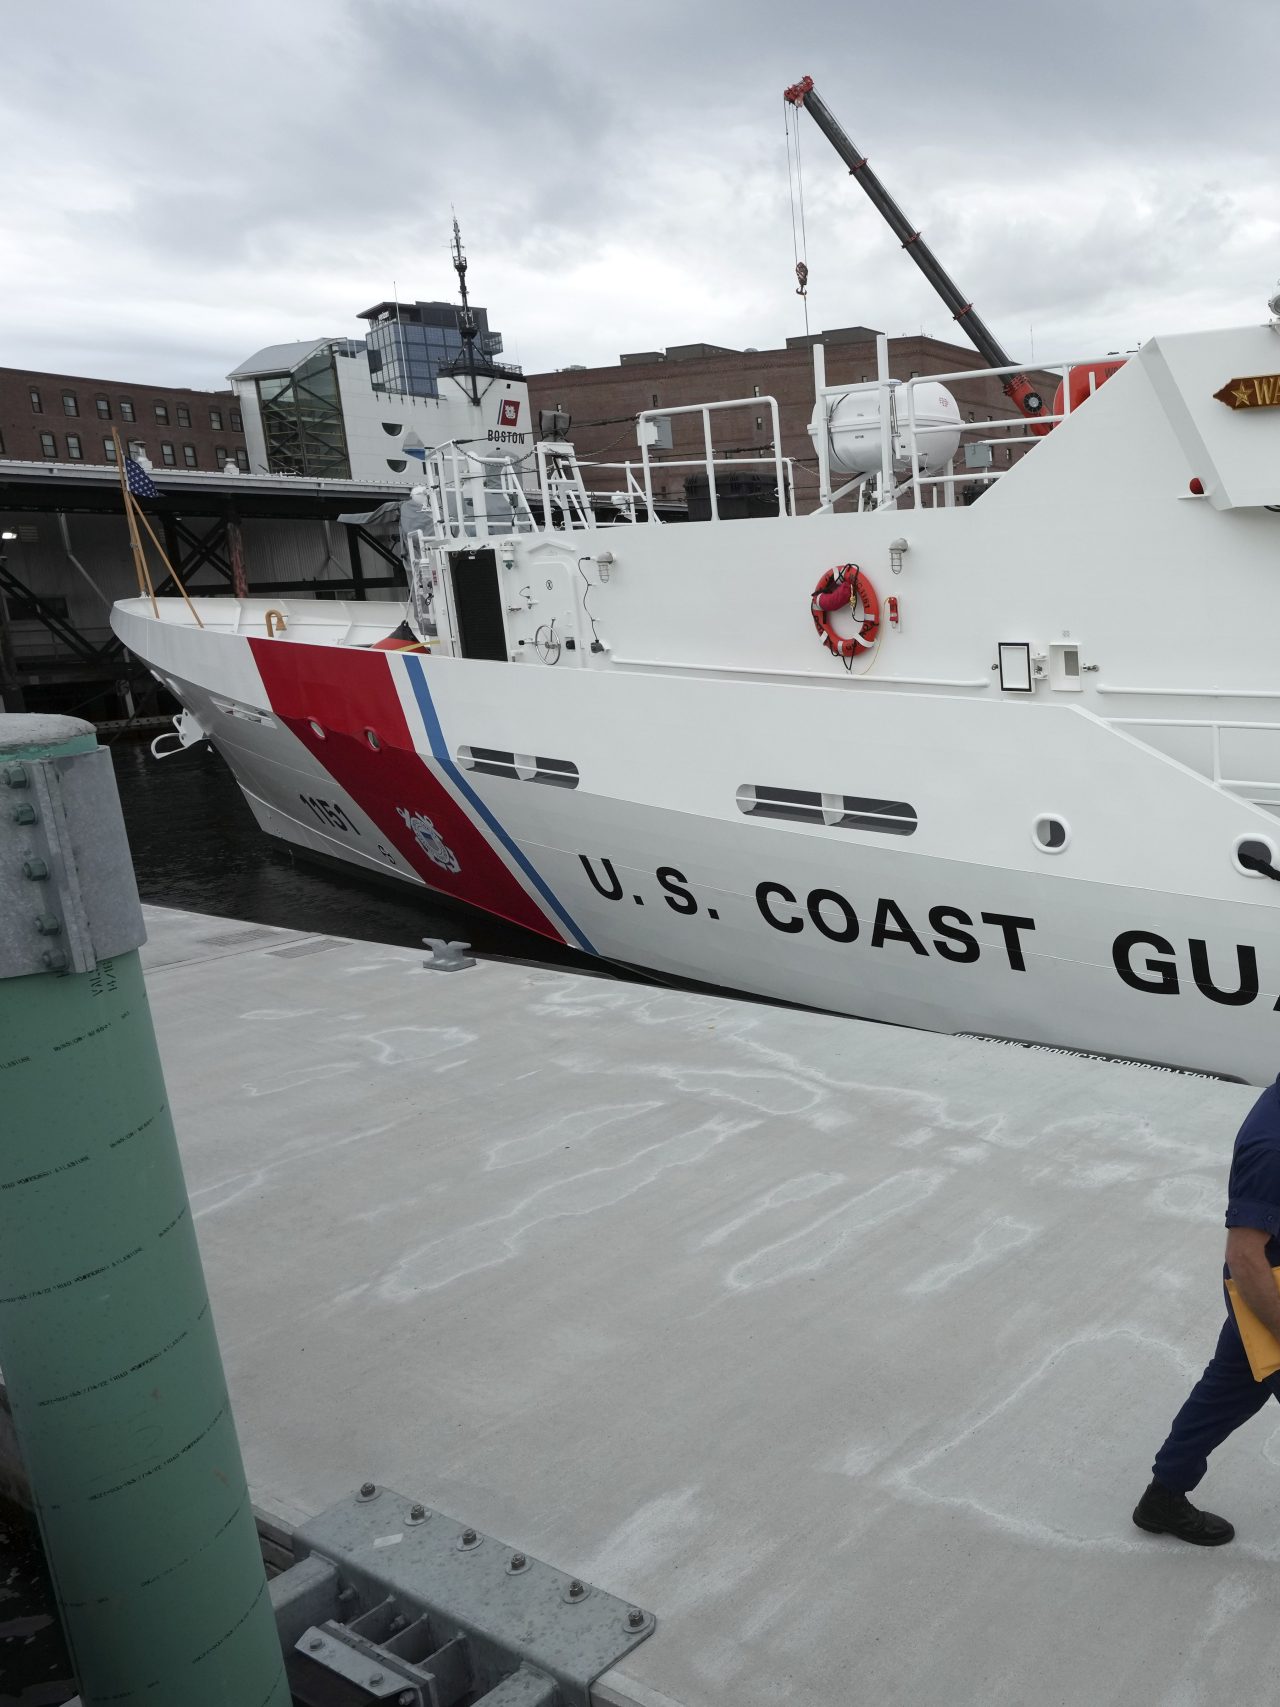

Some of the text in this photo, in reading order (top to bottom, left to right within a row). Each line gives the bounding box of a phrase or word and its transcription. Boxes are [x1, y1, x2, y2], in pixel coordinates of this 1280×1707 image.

[487, 429, 525, 444] BOSTON
[300, 793, 361, 836] 1151
[755, 881, 1036, 972] COAST
